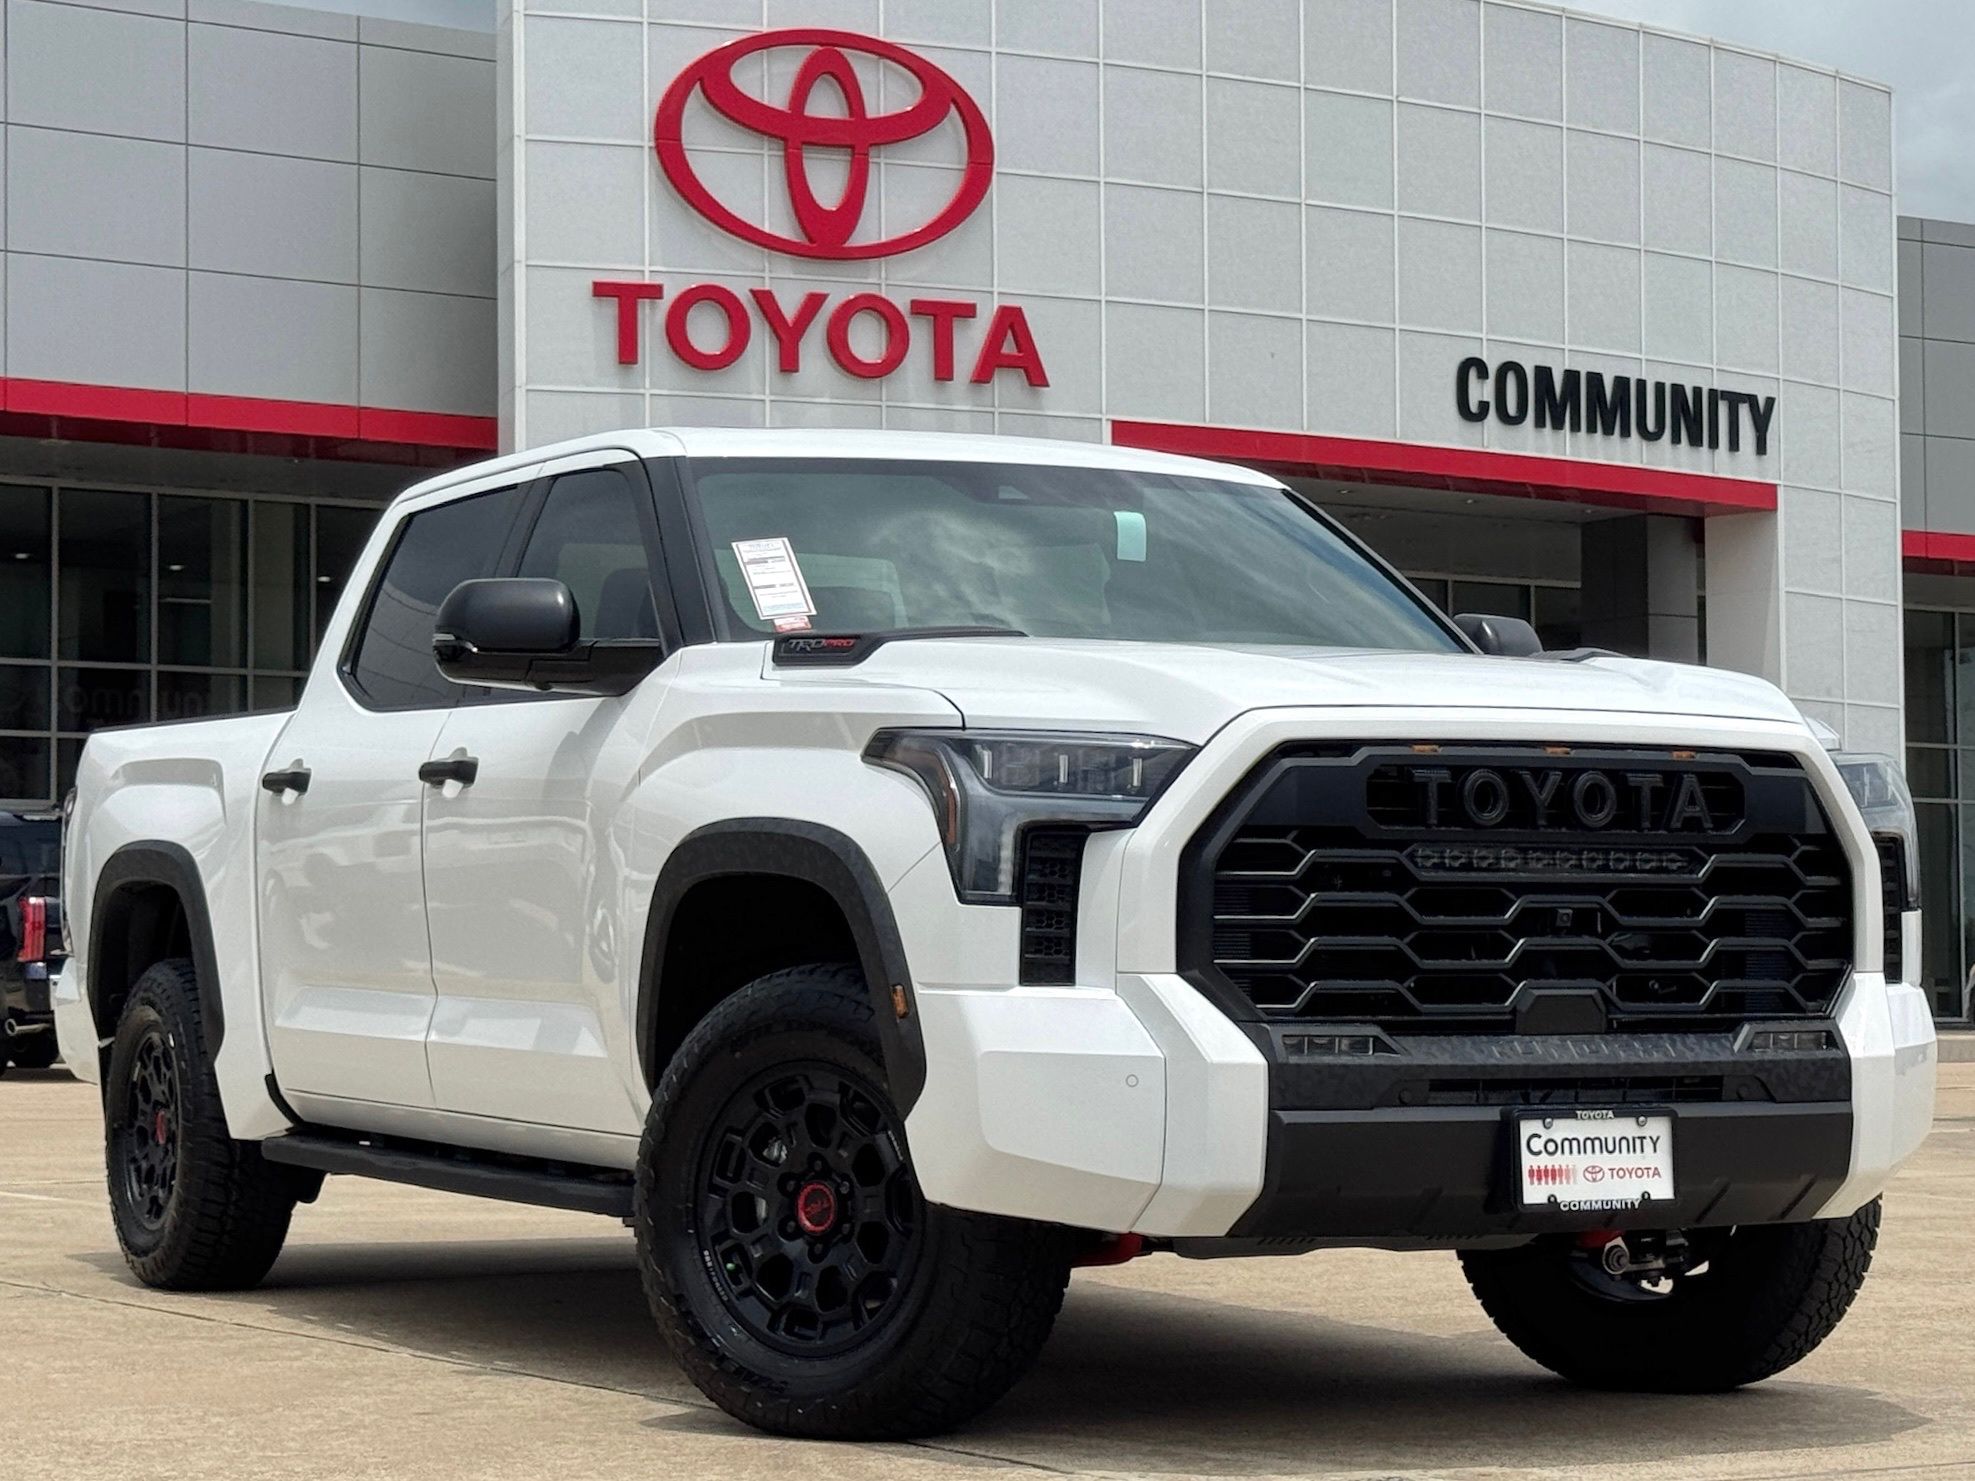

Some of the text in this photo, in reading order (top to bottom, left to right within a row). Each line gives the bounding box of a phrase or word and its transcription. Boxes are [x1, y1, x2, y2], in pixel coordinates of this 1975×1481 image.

[592, 280, 1050, 388] TOYOTA
[1456, 357, 1776, 456] COMMUNITY
[1411, 768, 1714, 829] TOYOTA
[1575, 1110, 1615, 1121] TOYOTA
[1608, 1167, 1662, 1180] TOYOTA
[1559, 1199, 1641, 1211] COMMUNITY
